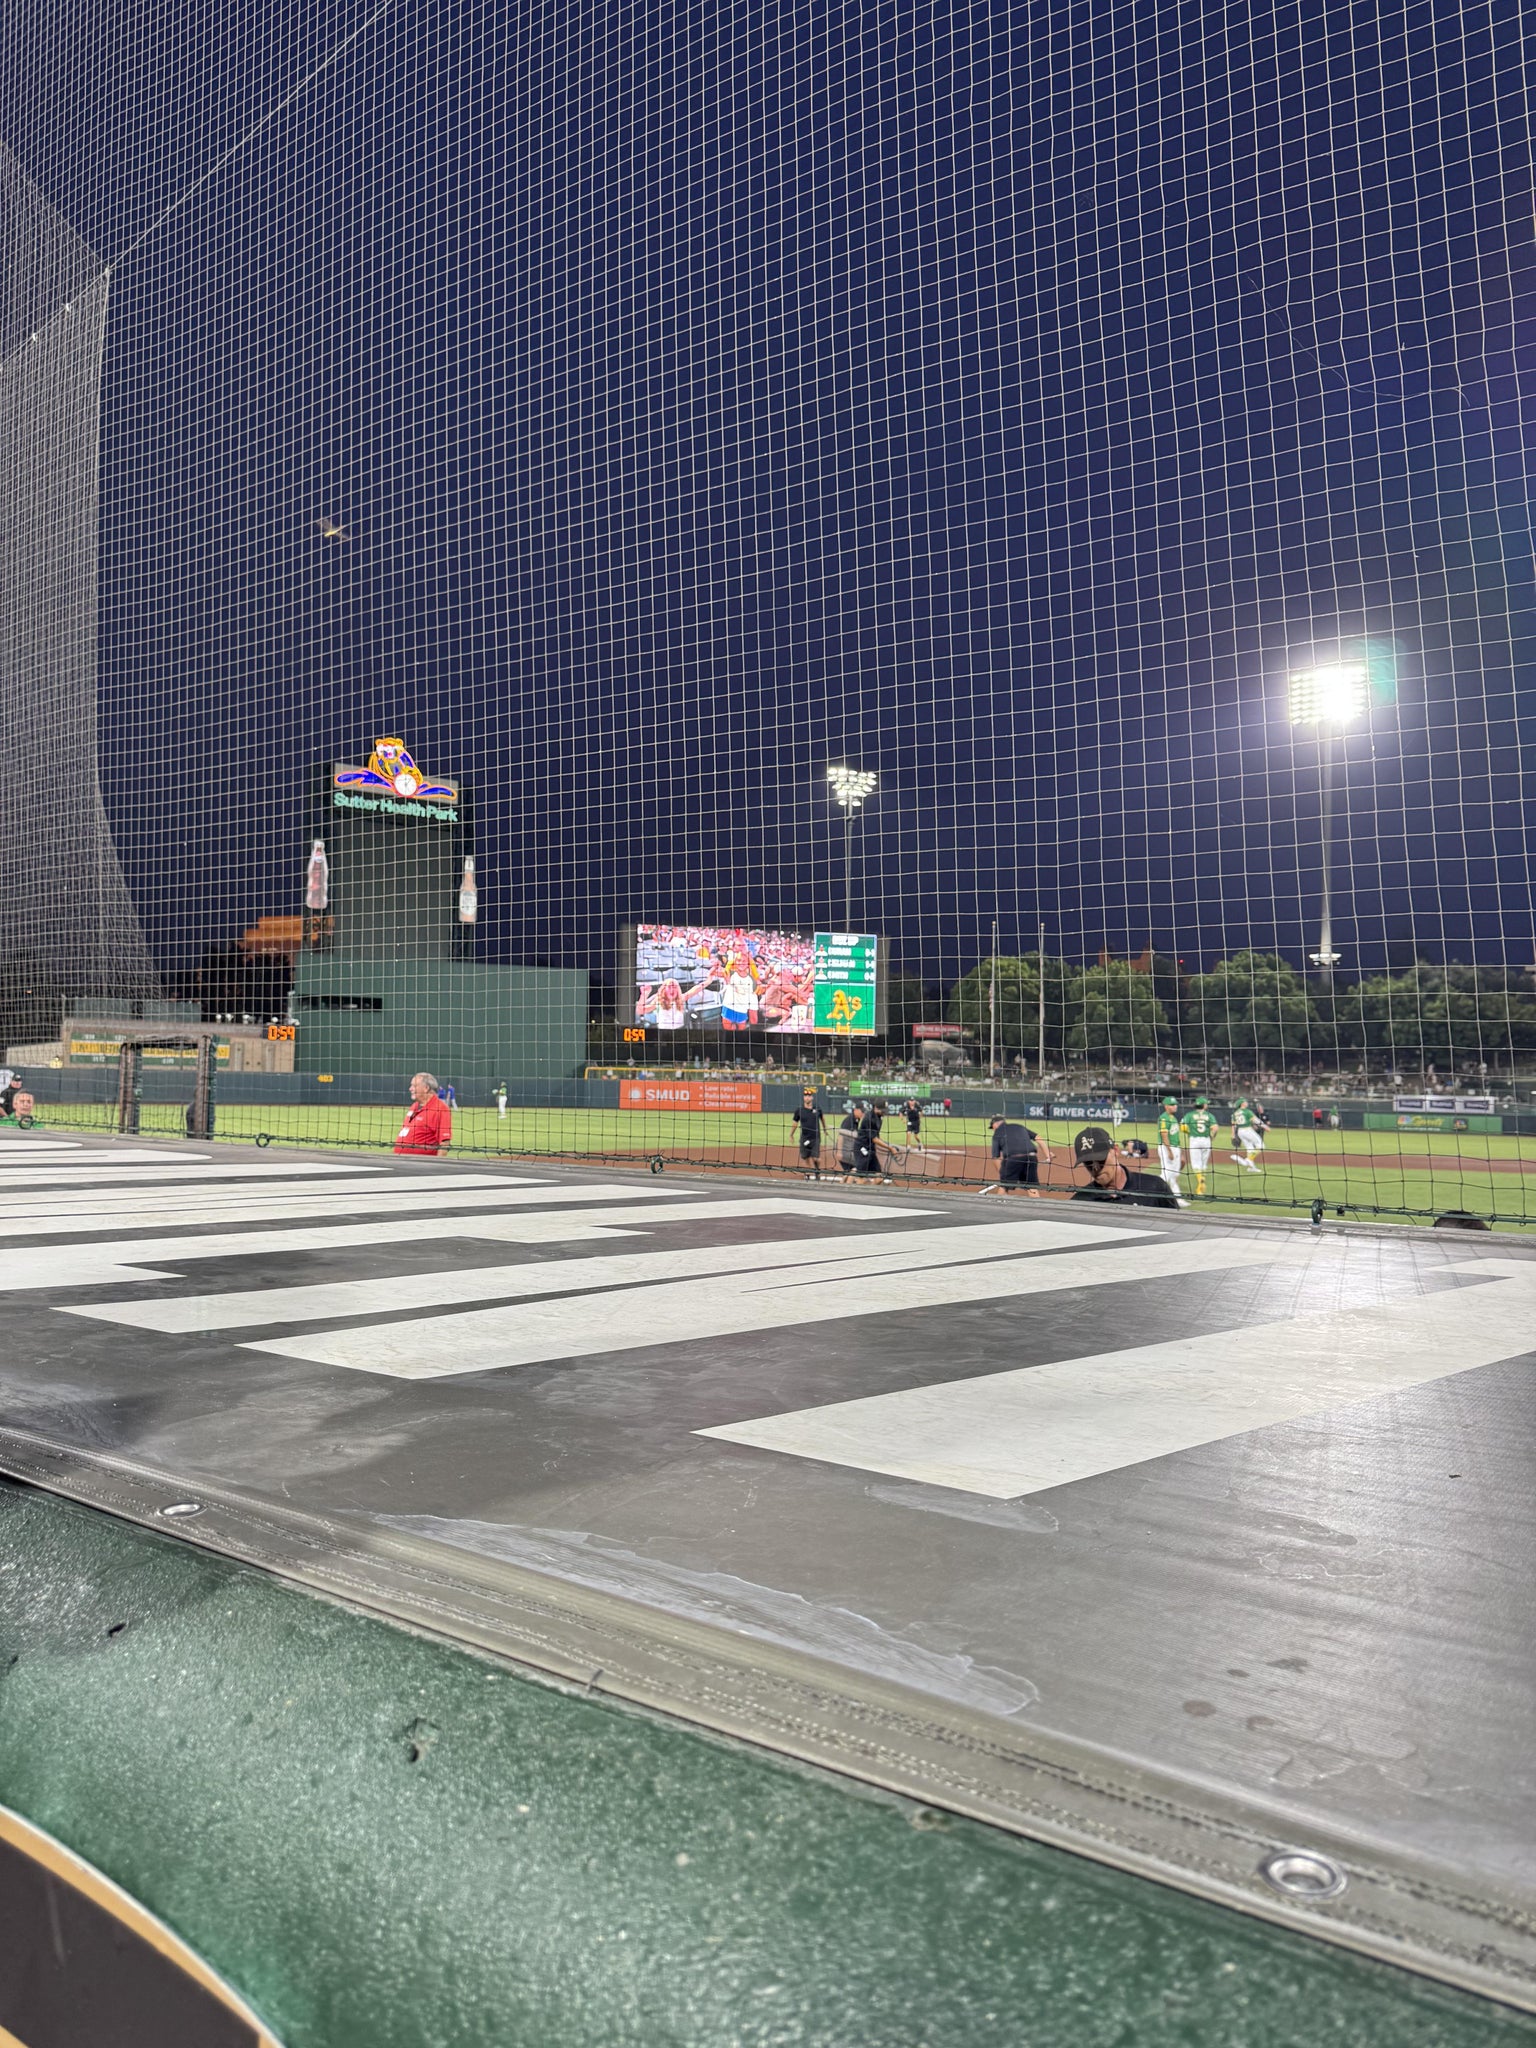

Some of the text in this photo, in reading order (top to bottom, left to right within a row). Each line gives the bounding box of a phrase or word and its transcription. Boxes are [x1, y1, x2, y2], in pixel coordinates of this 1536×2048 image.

[334, 792, 458, 821] Sutter Health Park
[645, 1088, 690, 1101] SMUD
[1029, 1105, 1129, 1119] SK RIVER CASIO
[1196, 1119, 1207, 1133] 5
